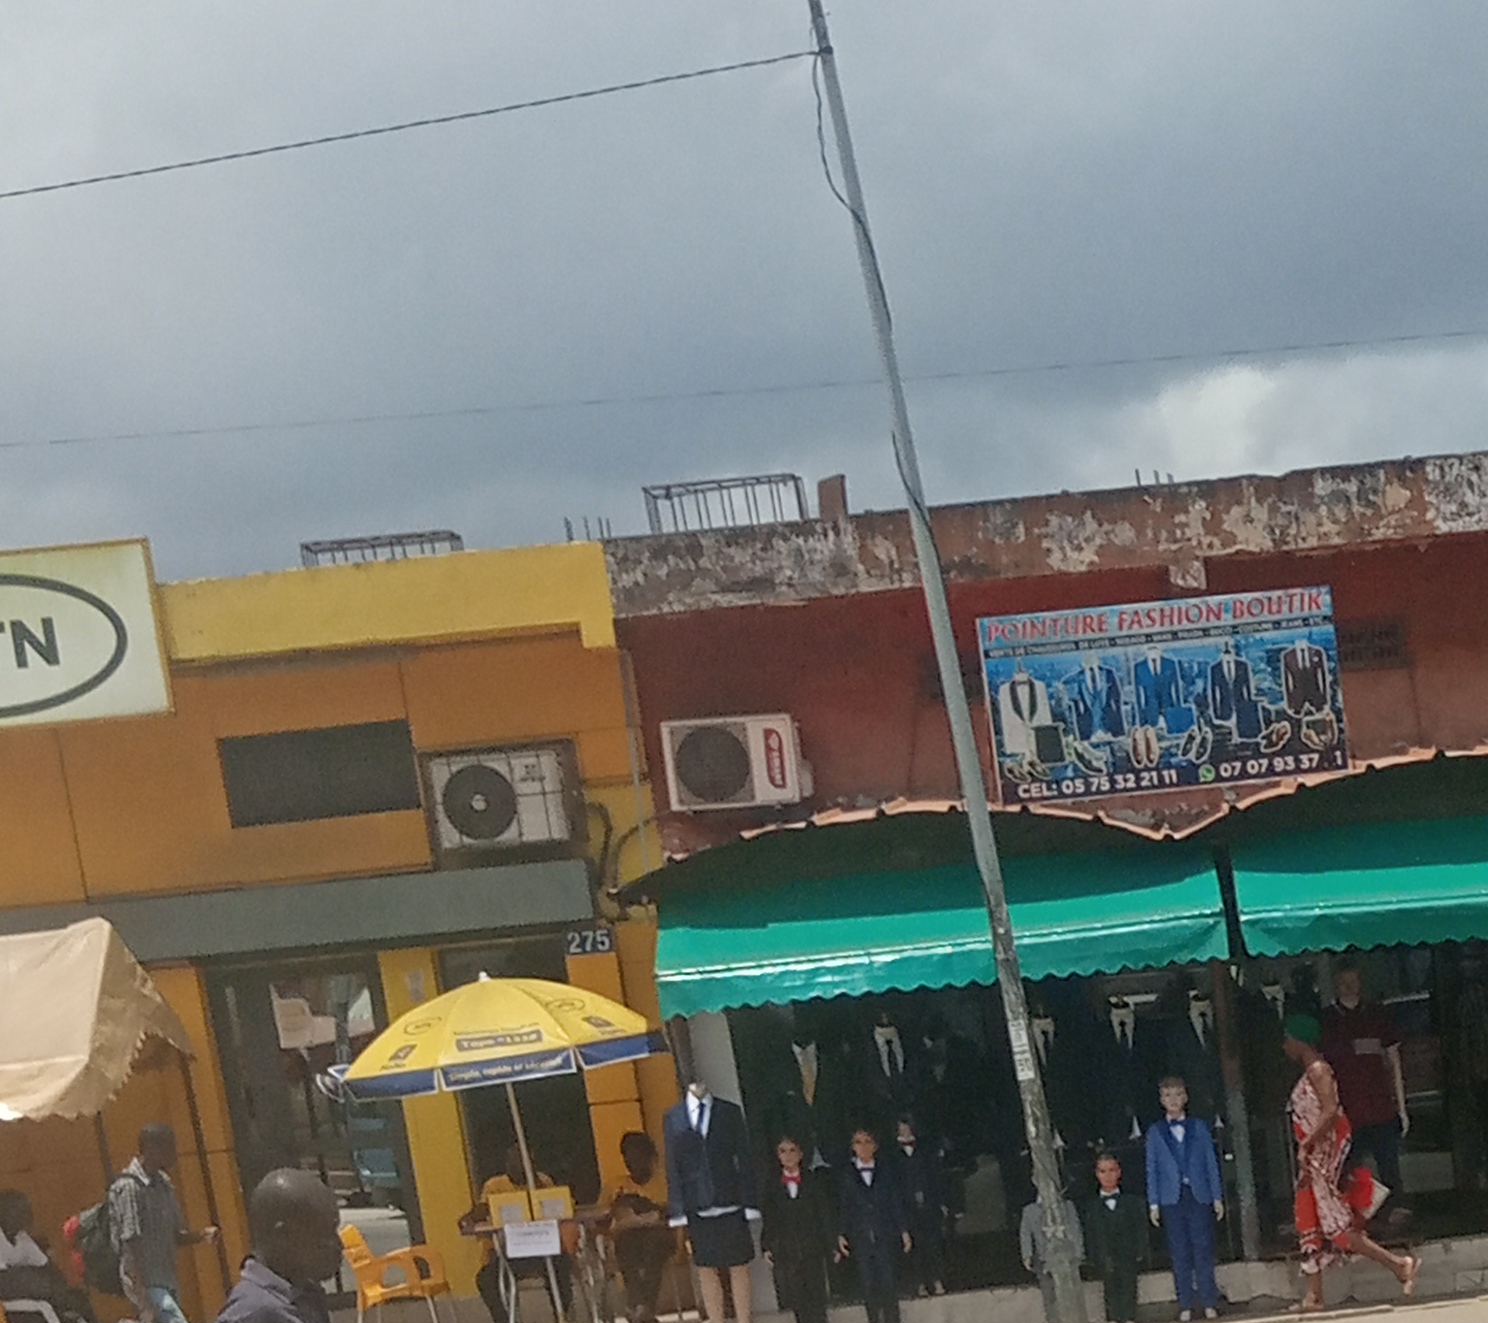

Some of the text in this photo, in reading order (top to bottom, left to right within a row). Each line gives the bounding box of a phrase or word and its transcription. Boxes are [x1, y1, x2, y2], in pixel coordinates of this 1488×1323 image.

[988, 592, 1323, 643] POINTURE FASHION BOUTIK
[0, 617, 60, 669] N
[1219, 761, 1243, 778] 07
[1246, 758, 1269, 775] 07
[1273, 755, 1296, 772] 93
[1299, 752, 1320, 769] 37
[1017, 768, 1178, 799] CEL: 05 75 32 21 11
[567, 930, 610, 953] 275
